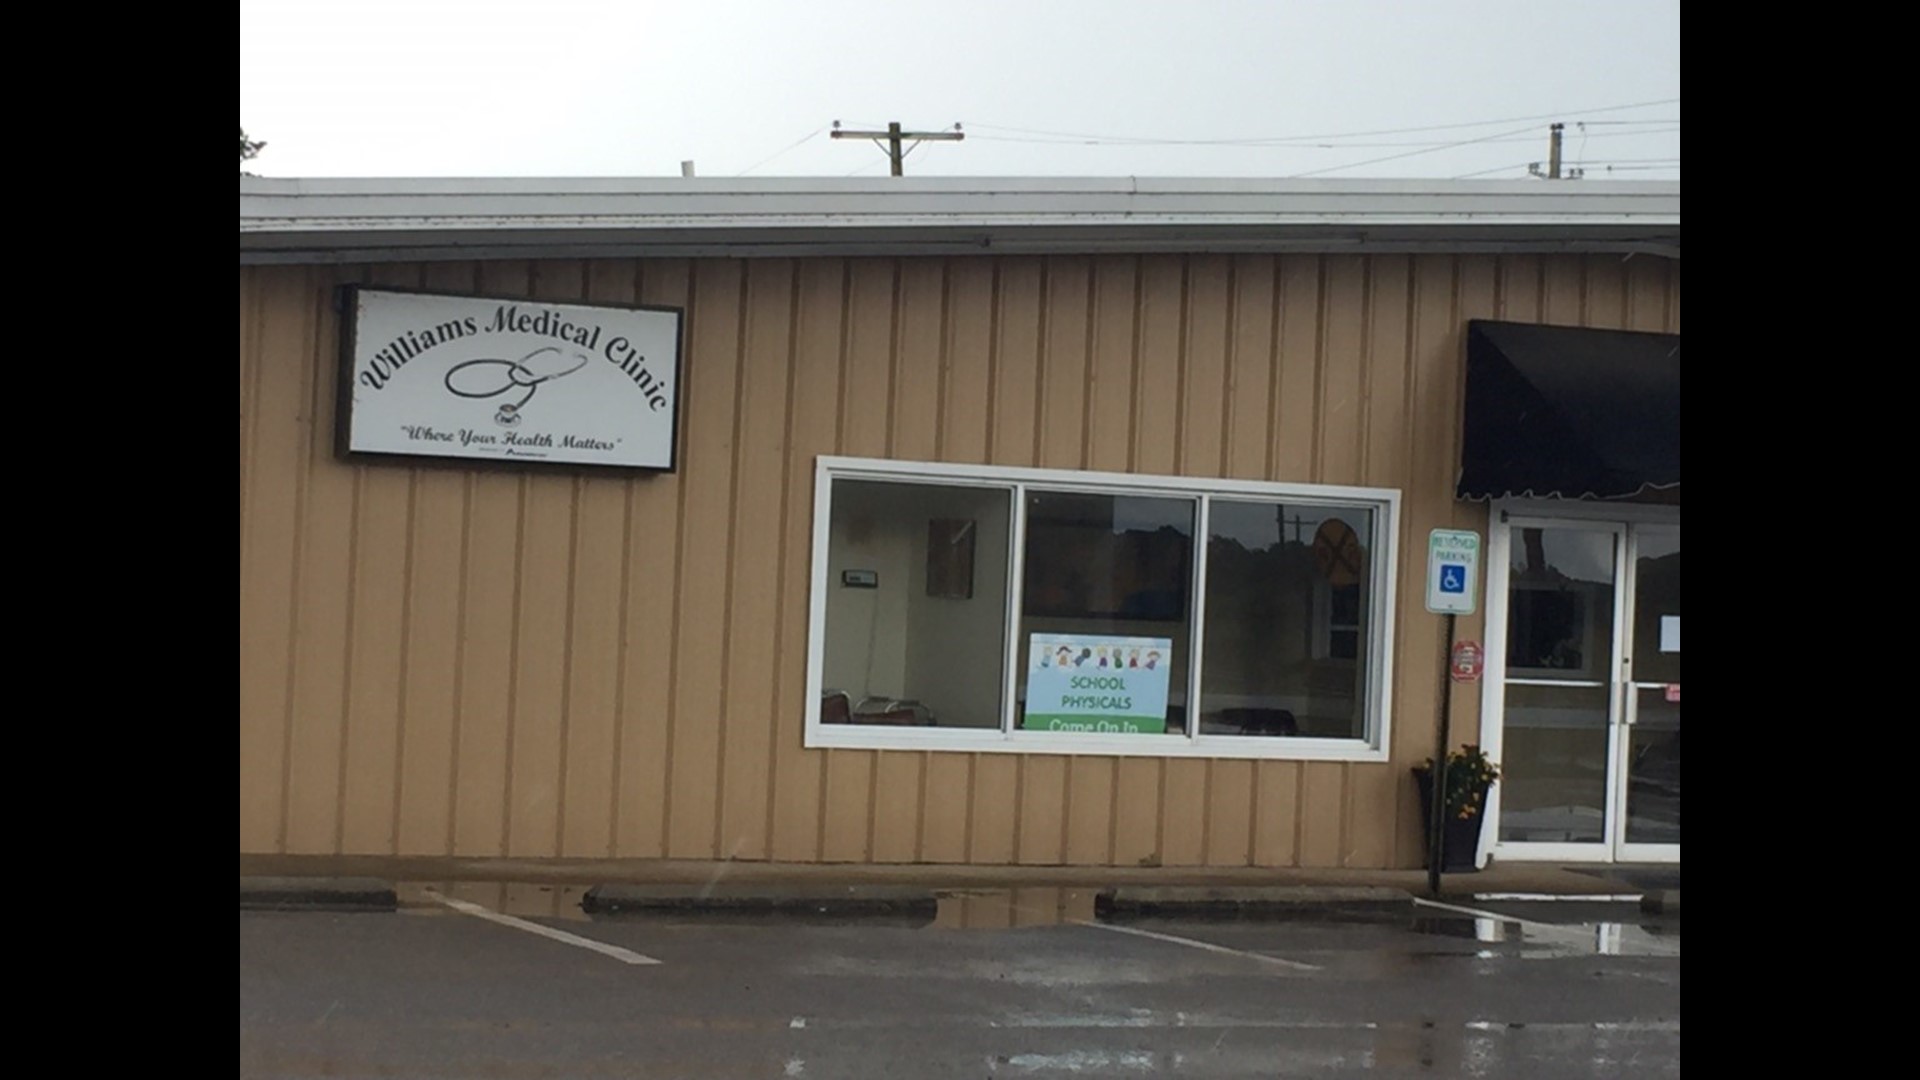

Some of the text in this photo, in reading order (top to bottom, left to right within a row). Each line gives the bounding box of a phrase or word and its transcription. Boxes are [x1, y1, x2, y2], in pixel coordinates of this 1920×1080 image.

[360, 306, 667, 412] Williams Medical Clinic
[458, 429, 497, 446] Your
[501, 431, 552, 447] Health
[1436, 550, 1472, 563] PARKING
[1070, 676, 1126, 690] SCHOOL
[1061, 695, 1132, 709] PHYSICALS
[1049, 719, 1138, 733] Come On In
